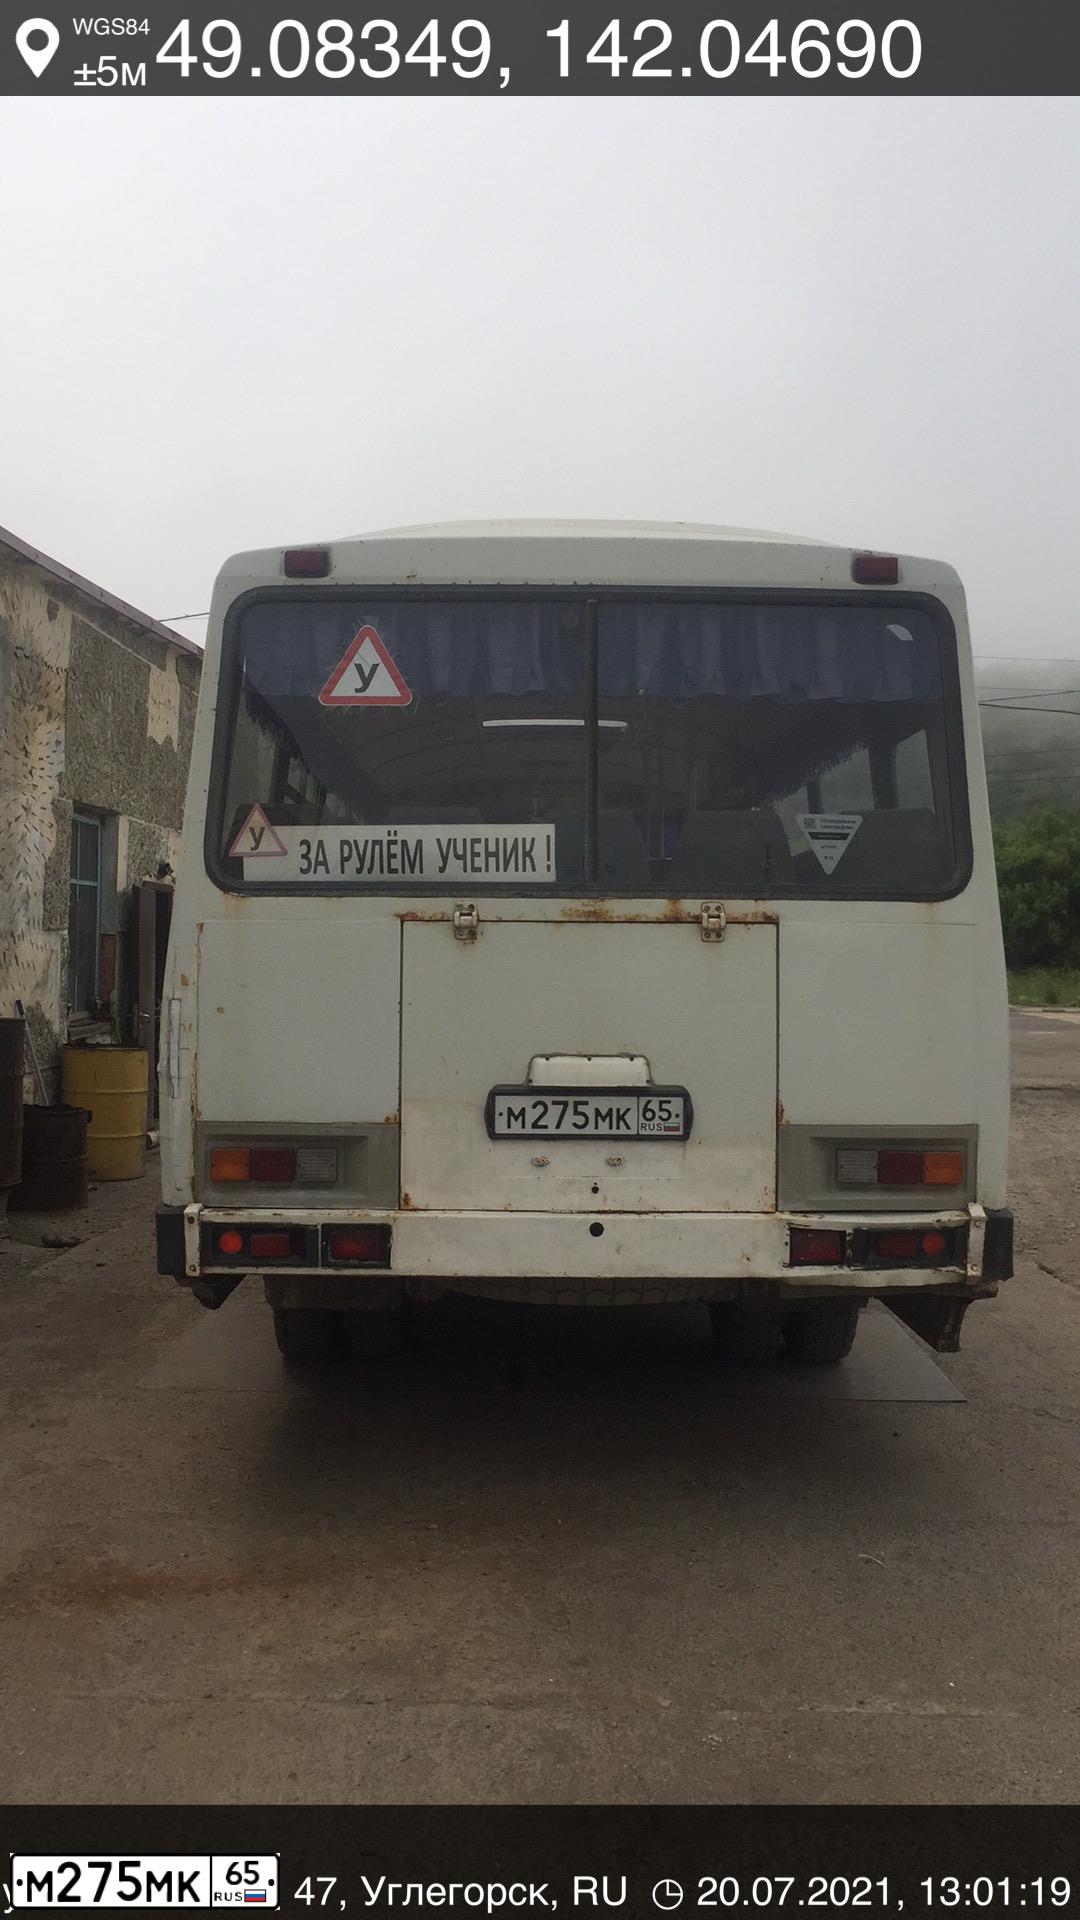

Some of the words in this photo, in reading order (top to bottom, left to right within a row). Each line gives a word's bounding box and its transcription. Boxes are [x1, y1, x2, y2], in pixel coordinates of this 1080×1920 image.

[299, 838, 330, 875] ЗА
[339, 830, 424, 875] РУЛЁМ
[435, 837, 537, 874] УЧЕНИК
[641, 1099, 673, 1122] 65
[640, 1122, 663, 1132] RUS
